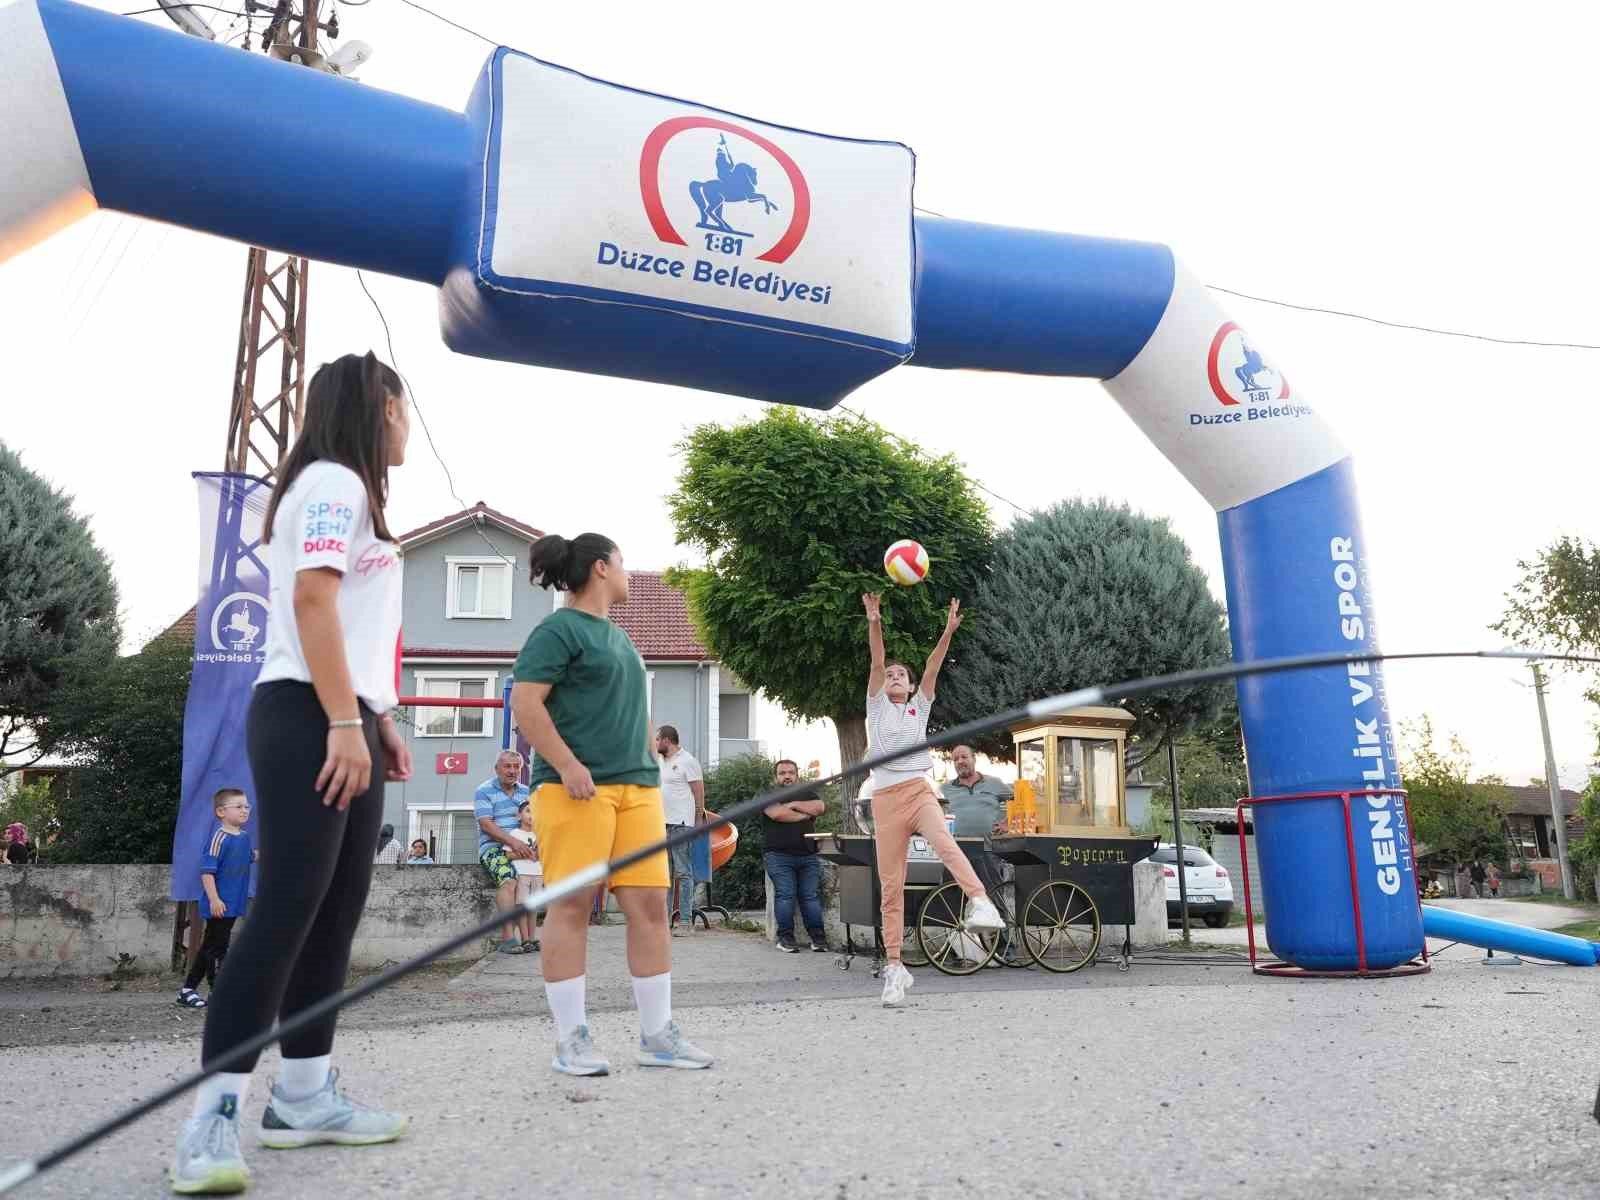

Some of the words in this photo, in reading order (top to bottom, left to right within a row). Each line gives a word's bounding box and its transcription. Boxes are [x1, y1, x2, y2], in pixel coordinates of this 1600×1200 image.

[597, 241, 686, 278] Düzce
[693, 260, 832, 304] Belediyesi
[1190, 412, 1242, 425] Düzce
[304, 539, 345, 553] DÜZC
[1330, 536, 1365, 641] SPOR
[1347, 653, 1374, 707] VE
[1353, 717, 1401, 895] GENÇLİK
[1057, 846, 1128, 866] Popcorn
